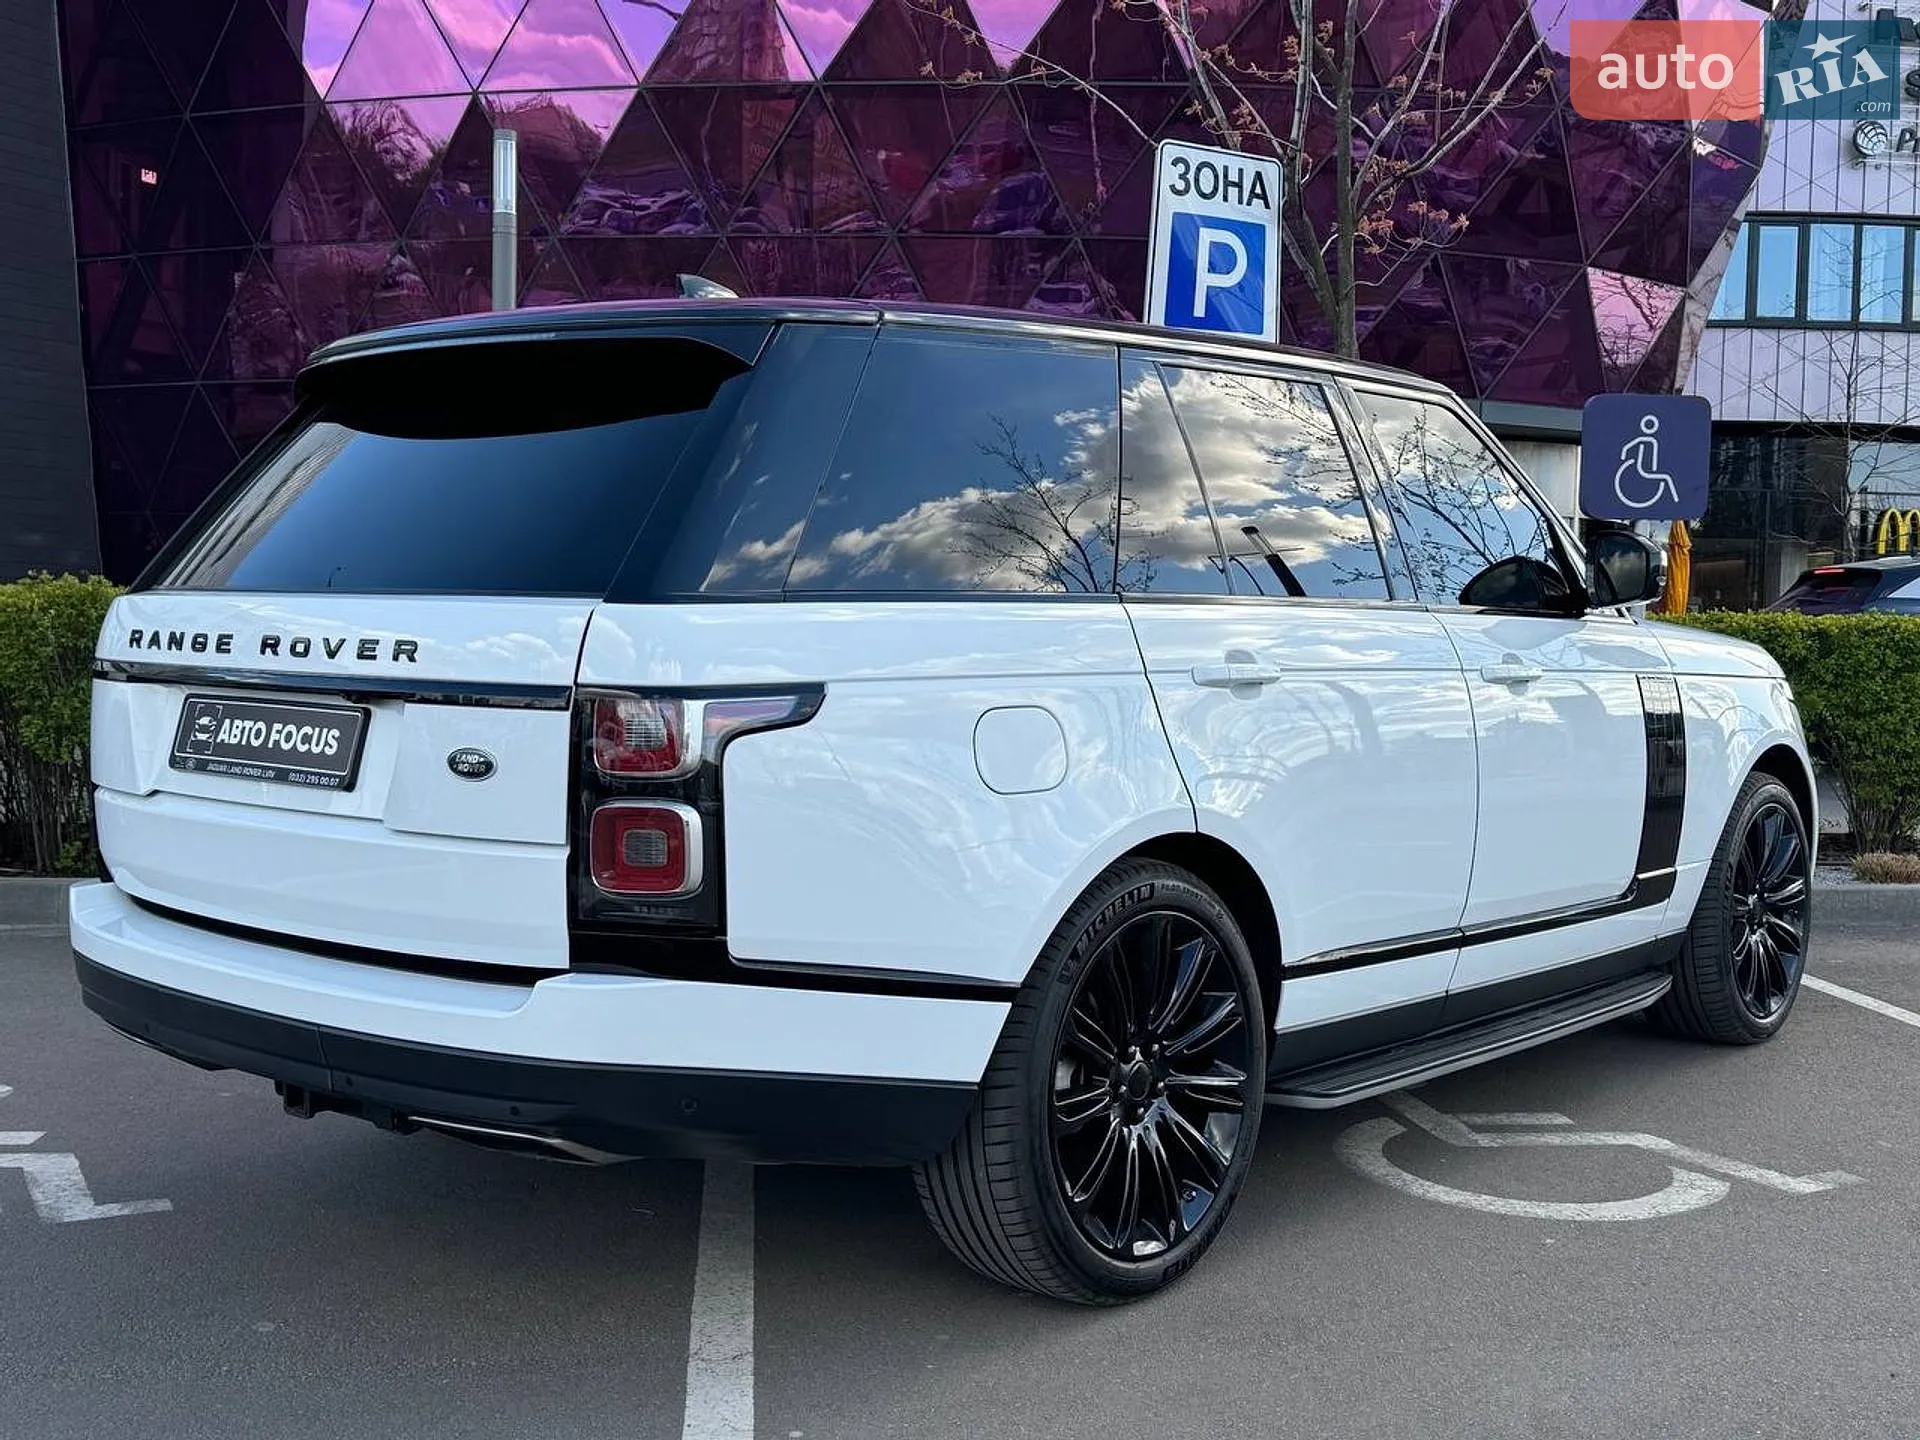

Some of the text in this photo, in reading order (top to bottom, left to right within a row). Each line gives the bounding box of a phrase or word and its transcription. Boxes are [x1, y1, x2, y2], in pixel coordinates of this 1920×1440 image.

[1168, 156, 1271, 210] ЗОНА
[1192, 227, 1248, 318] P
[128, 629, 419, 663] RANGE ROVER
[216, 718, 341, 756] АВТО FOCUS
[1075, 884, 1152, 957] MICHELIN
